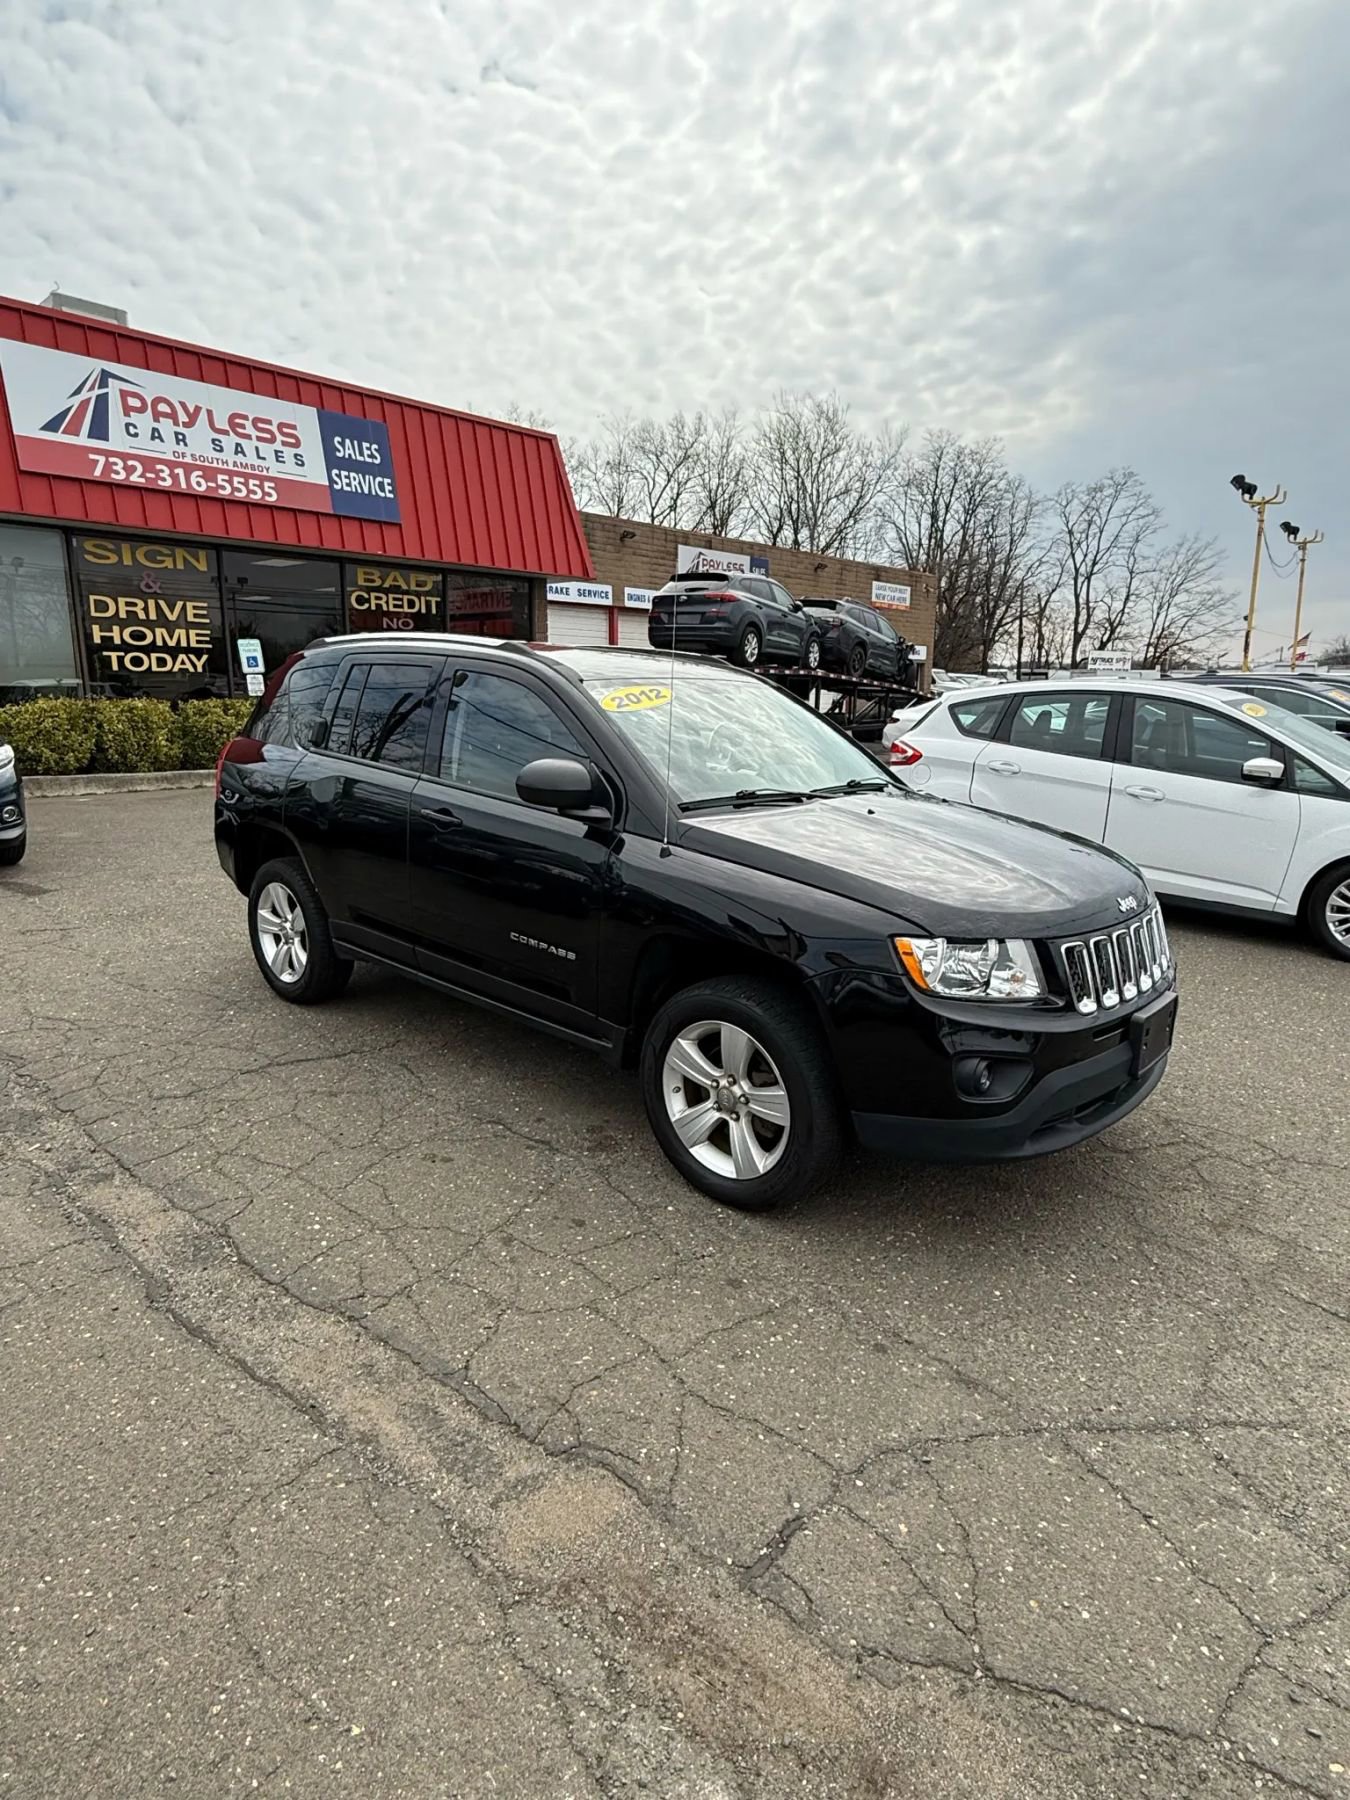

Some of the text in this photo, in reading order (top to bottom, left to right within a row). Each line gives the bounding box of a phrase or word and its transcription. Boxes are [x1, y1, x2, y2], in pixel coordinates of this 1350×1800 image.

[118, 388, 302, 449] PAYLESS
[124, 422, 306, 468] CAR SALES
[333, 436, 381, 464] SALES
[172, 450, 271, 474] OF SOUTH AMBOY
[88, 453, 278, 502] 732-316-5555
[331, 469, 394, 498] SERVICE
[82, 540, 208, 571] SIGN
[701, 558, 745, 572] PAYLESS
[140, 571, 162, 593] &
[357, 567, 434, 591] BAD
[350, 590, 441, 614] CREDIT
[548, 586, 610, 600] RAKE SERVICE
[88, 594, 210, 623] DRIVE
[382, 617, 414, 630] NO
[91, 624, 213, 648] HOME
[102, 651, 209, 673] TODAY
[610, 688, 668, 709] 2012
[1116, 895, 1137, 912] Jeep
[510, 931, 577, 960] COMPASS
